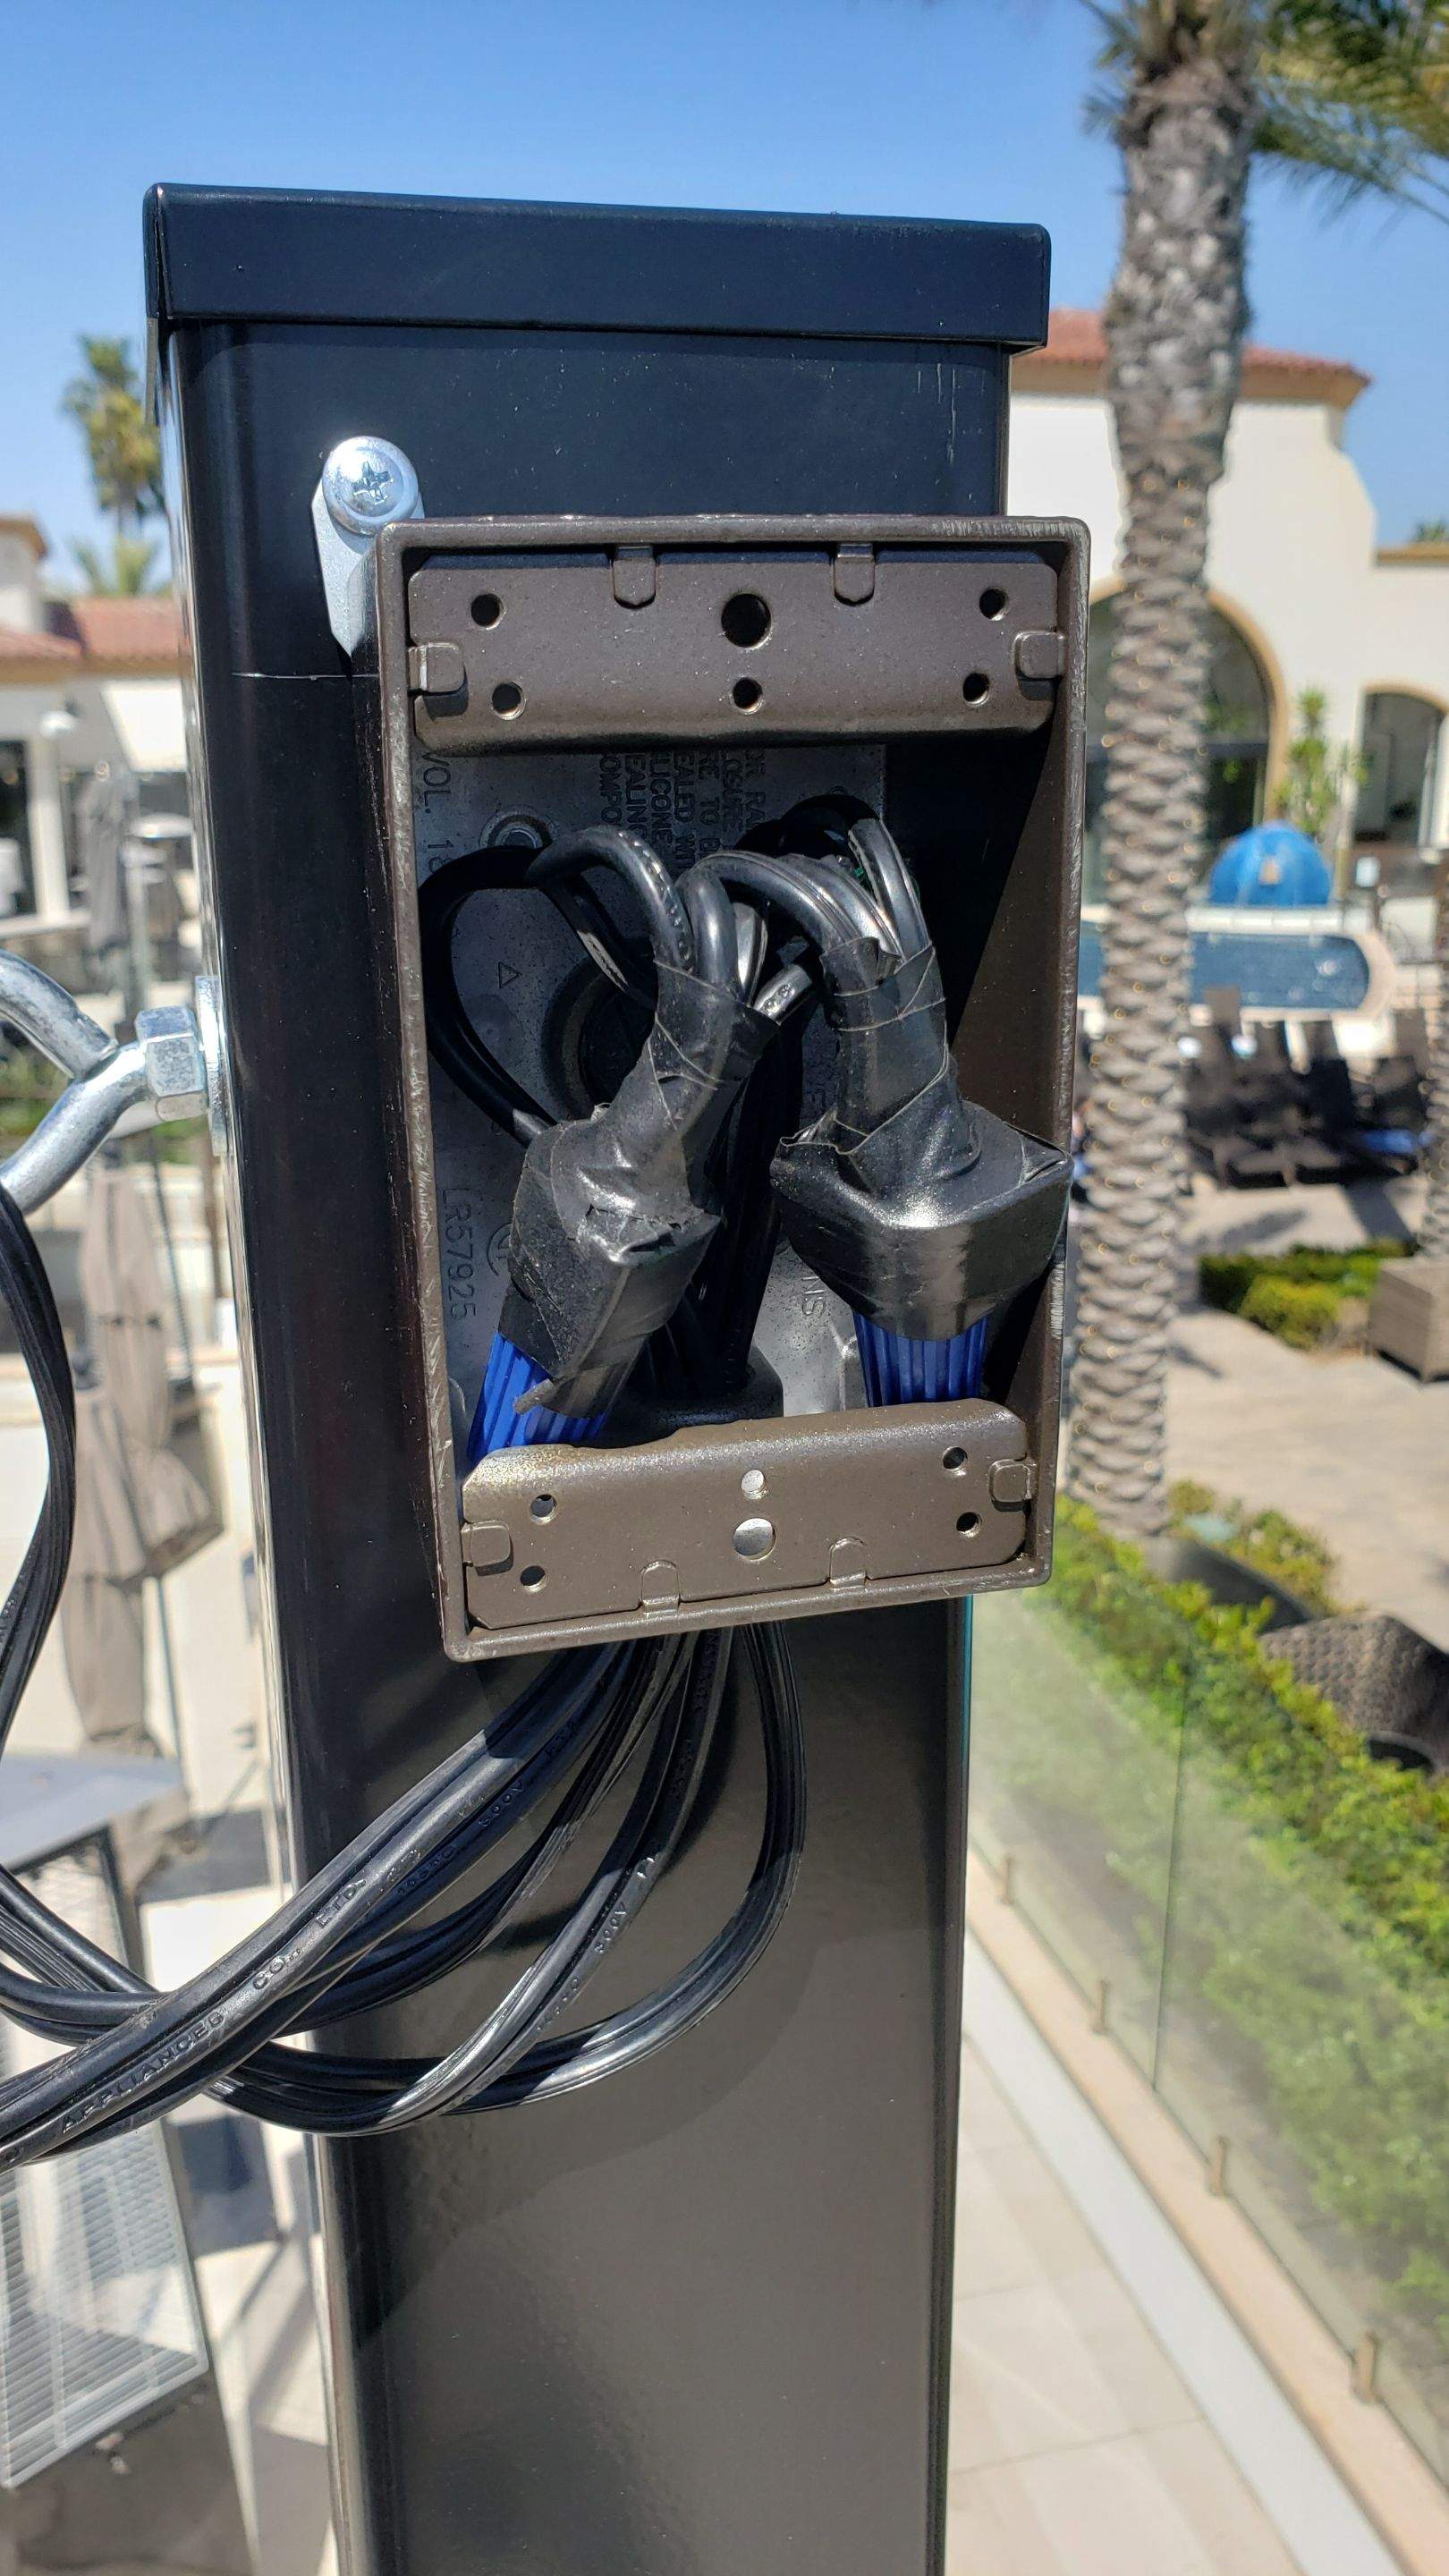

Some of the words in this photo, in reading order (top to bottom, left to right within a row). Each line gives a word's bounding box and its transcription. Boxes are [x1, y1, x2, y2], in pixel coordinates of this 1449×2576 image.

[599, 753, 622, 826] OMPO
[674, 752, 695, 823] EALED
[699, 796, 718, 825] TO
[443, 1188, 477, 1320] LR57925
